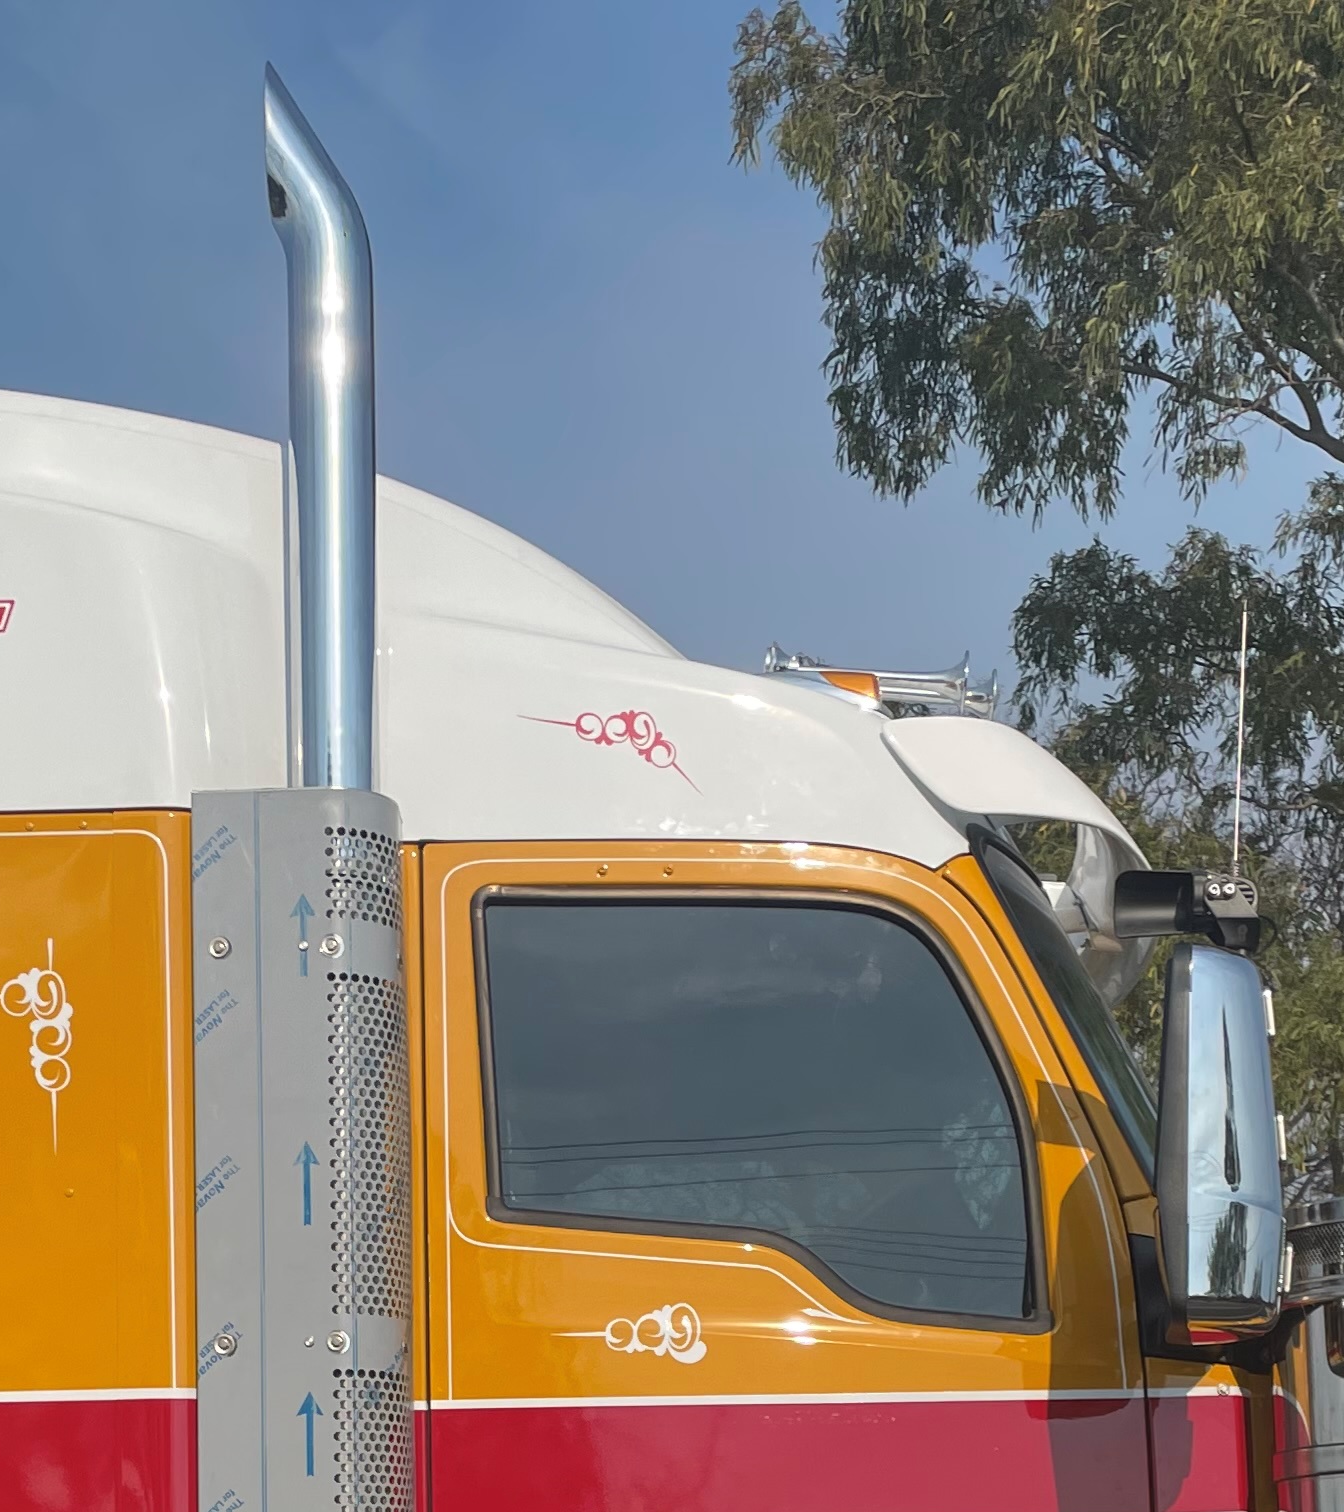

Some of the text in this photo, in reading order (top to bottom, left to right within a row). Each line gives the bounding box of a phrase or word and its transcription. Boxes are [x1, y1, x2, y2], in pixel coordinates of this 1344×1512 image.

[193, 824, 228, 861] for LASER
[219, 833, 238, 850] The
[195, 989, 230, 1025] for LASER
[195, 998, 239, 1043] The Nova
[197, 1155, 232, 1191] for LASER
[222, 1164, 241, 1180] The
[223, 1489, 236, 1502] for
